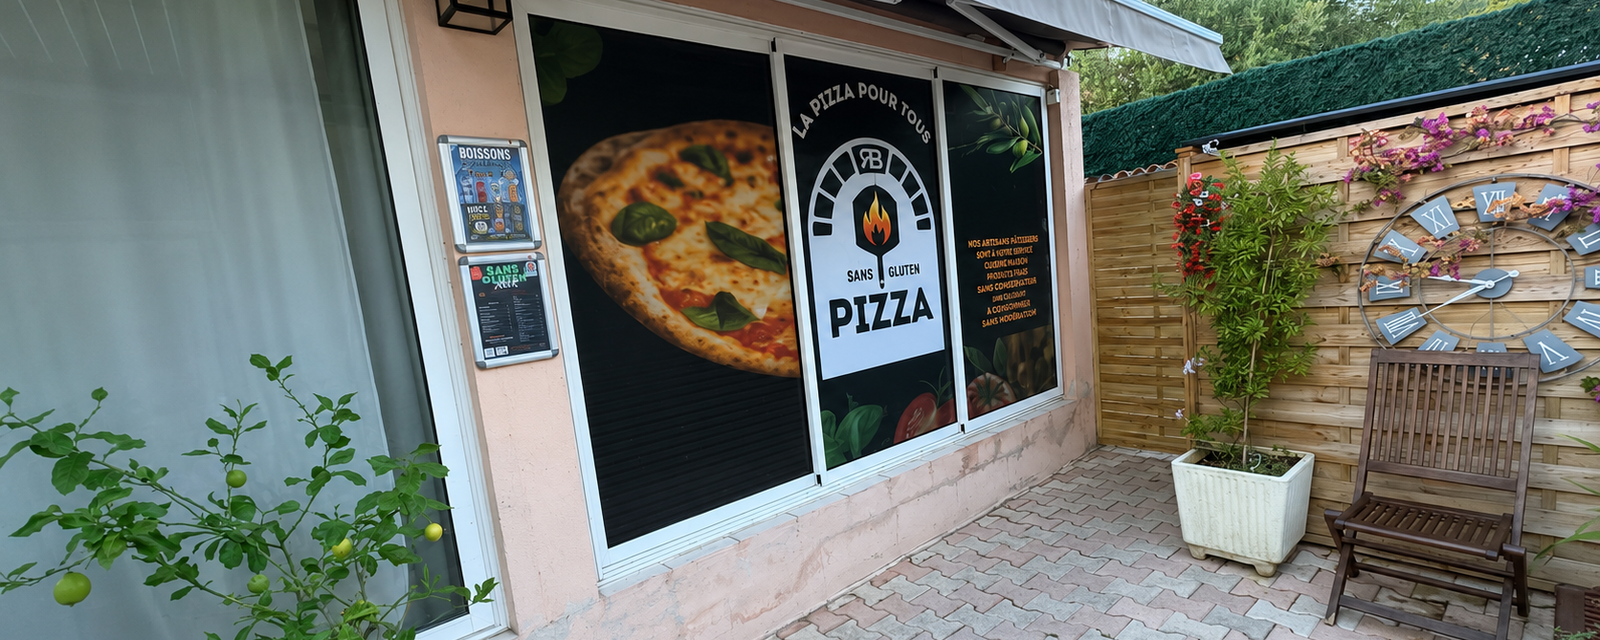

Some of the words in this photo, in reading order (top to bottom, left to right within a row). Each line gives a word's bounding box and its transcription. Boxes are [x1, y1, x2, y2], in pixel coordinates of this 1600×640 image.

[792, 113, 814, 139] LA
[809, 83, 855, 117] PIZZA
[858, 82, 898, 111] POUR
[900, 101, 931, 144] TOUS
[458, 146, 511, 160] BOISSONS
[967, 239, 981, 248] NOS
[486, 264, 519, 276] SANS
[847, 268, 874, 283] SANS
[888, 263, 920, 278] GLUTEN
[977, 283, 994, 294] SANS
[829, 287, 934, 338] PIZZA
[982, 317, 998, 328] SANS
